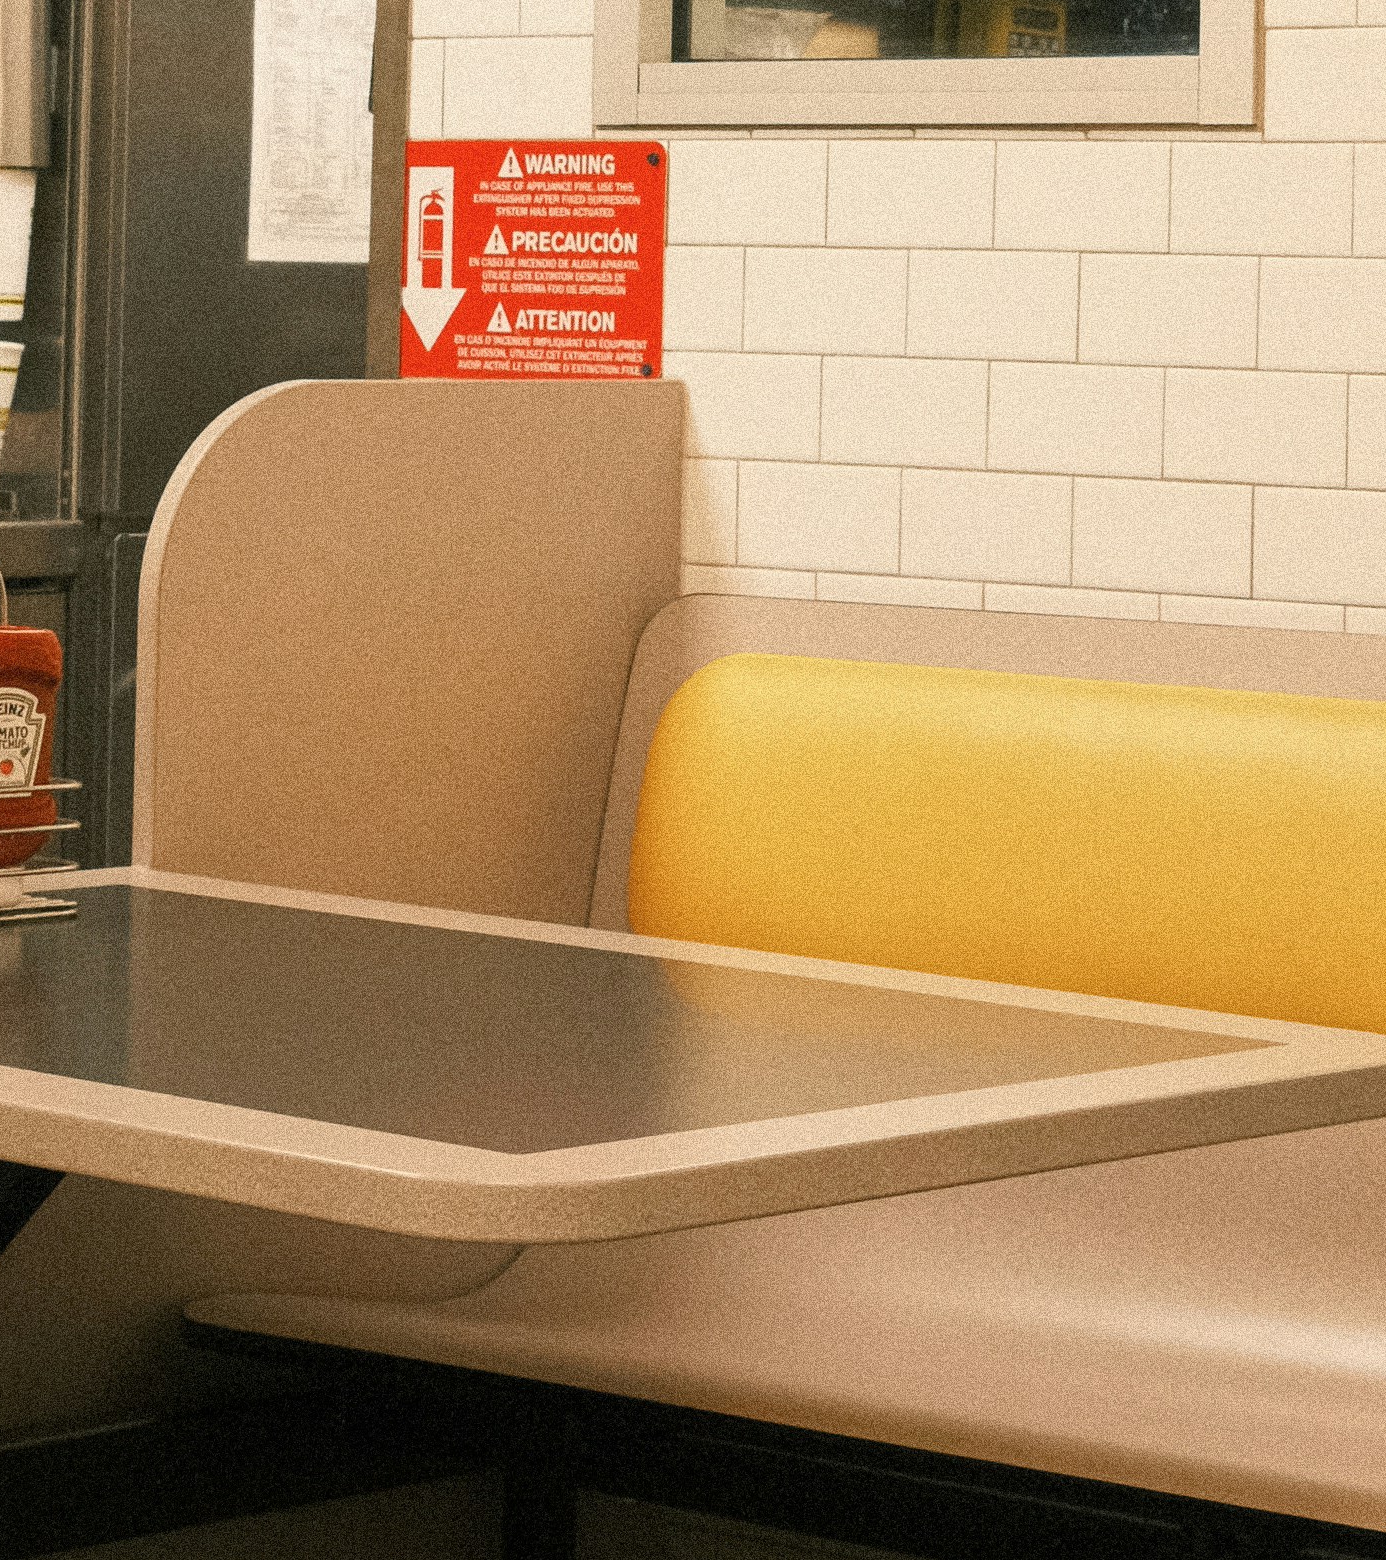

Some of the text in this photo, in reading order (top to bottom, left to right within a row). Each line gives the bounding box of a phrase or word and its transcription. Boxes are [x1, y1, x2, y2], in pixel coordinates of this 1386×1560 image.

[524, 153, 615, 176] WARNING
[512, 228, 638, 254] PRECAUCIÓN
[515, 309, 615, 333] ATTENTION
